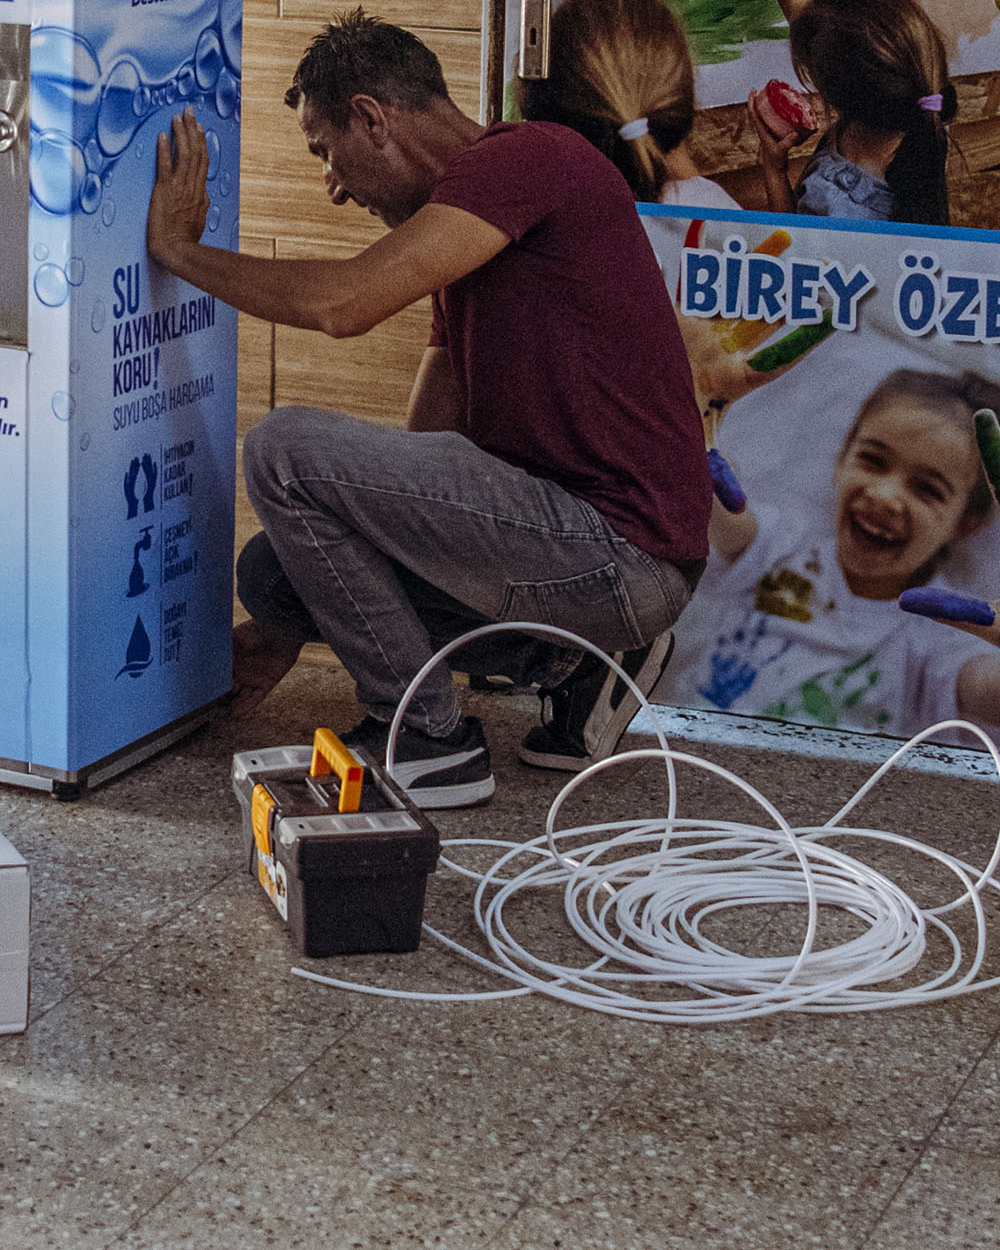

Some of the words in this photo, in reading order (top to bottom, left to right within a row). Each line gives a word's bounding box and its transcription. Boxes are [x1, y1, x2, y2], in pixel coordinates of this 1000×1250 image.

[112, 261, 140, 320] SU
[685, 238, 872, 326] BİREY
[112, 294, 216, 360] KAYNAKLARINI
[112, 346, 161, 398] KORU!
[112, 400, 140, 432] SUYU
[141, 389, 168, 421] BOŞA
[168, 372, 216, 411] HARCAMA
